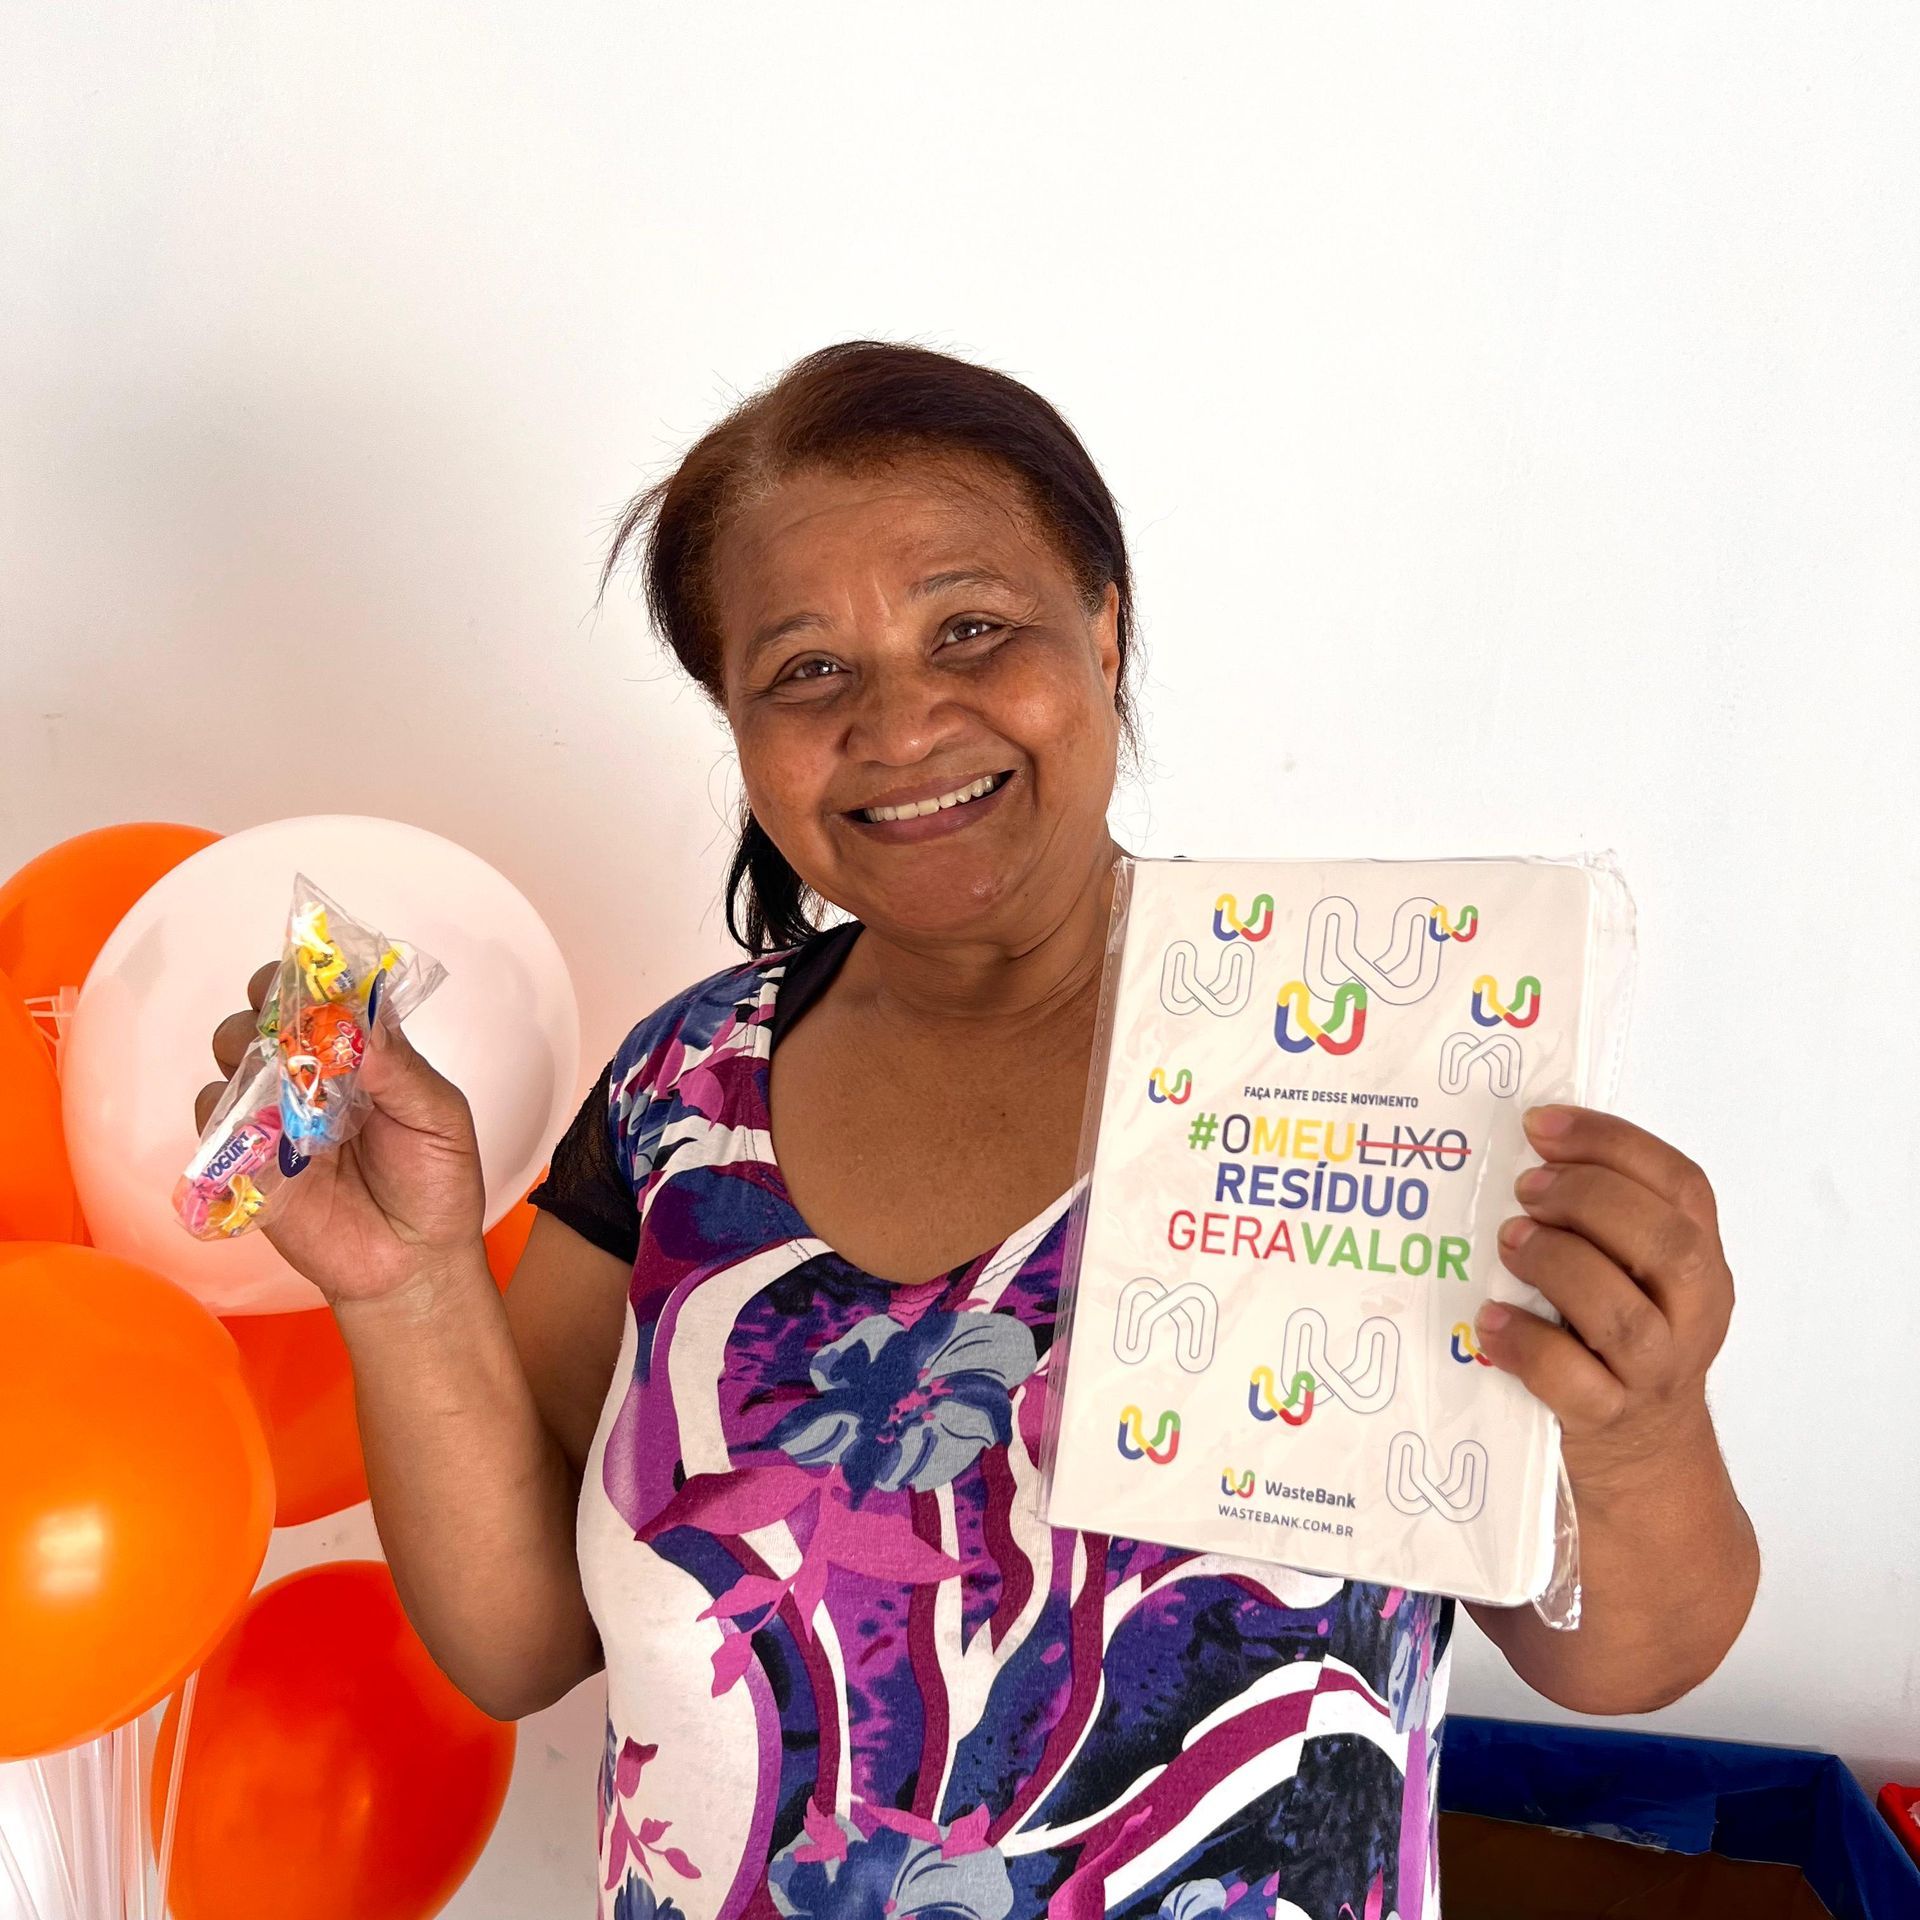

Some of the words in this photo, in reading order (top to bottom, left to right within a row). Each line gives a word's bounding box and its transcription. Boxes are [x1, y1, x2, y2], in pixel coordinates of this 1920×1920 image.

[1244, 1086, 1271, 1100] FAÇA
[1274, 1088, 1309, 1101] PARTE
[1312, 1090, 1348, 1104] DESSE
[1350, 1093, 1419, 1108] MOVIMENTO
[1215, 1161, 1429, 1221] RESÍDUO
[1265, 1480, 1356, 1509] WasteBank
[1218, 1504, 1354, 1537] WASTEBANK.COM.BR
